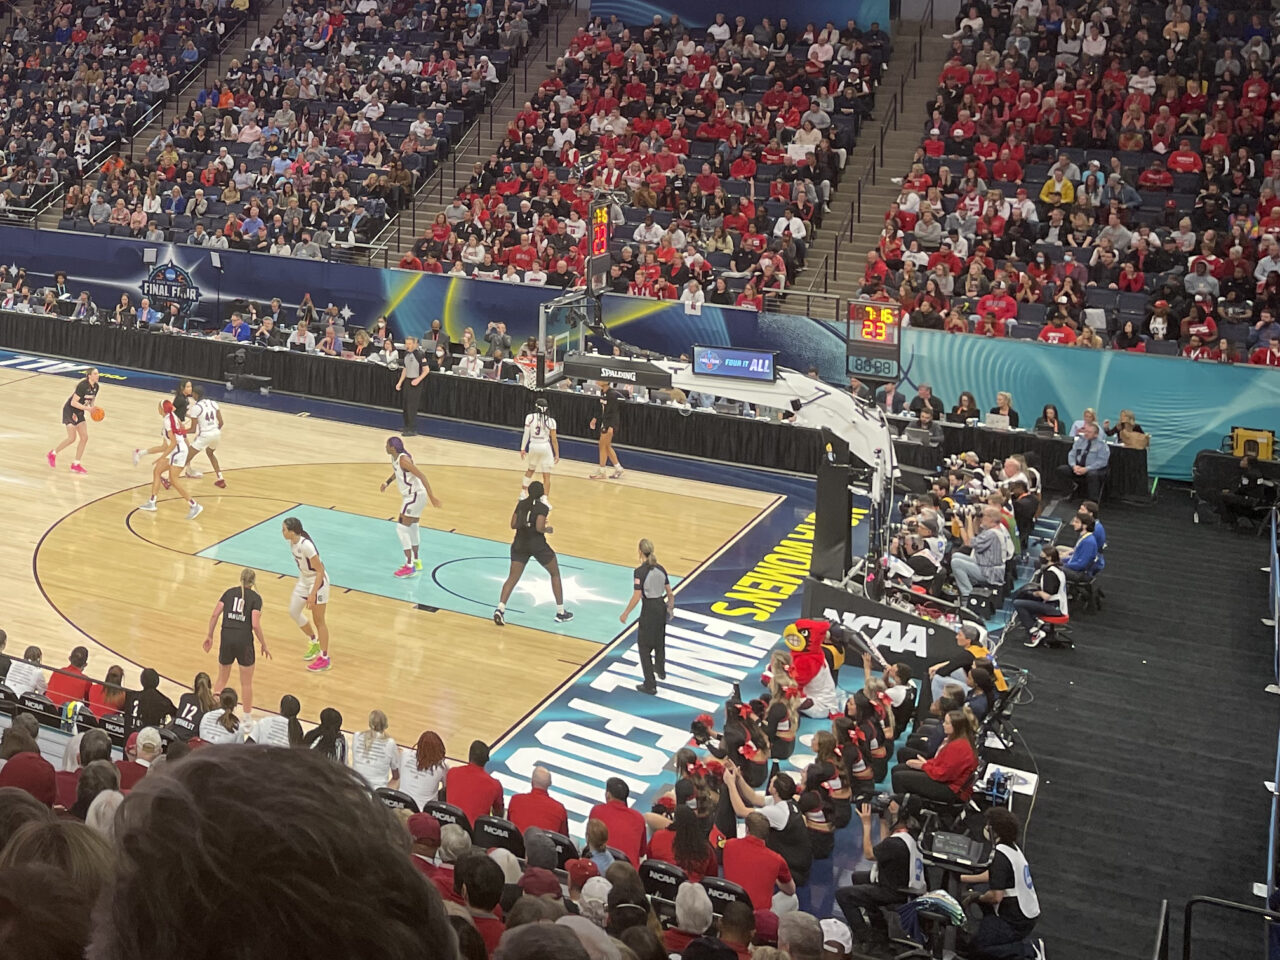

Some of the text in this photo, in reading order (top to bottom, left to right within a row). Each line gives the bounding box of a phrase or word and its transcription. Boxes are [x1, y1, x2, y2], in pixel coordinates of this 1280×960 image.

[144, 282, 170, 297] FINAL
[865, 306, 893, 324] 7:16
[862, 320, 886, 340] 23
[749, 358, 770, 373] ALL
[600, 367, 636, 382] SPALDING
[204, 411, 214, 422] 44
[710, 539, 814, 622] WOMEN'S
[232, 597, 244, 613] 10
[181, 703, 198, 721] 12
[431, 810, 457, 824] NCAA
[483, 824, 509, 838] NCAA
[649, 870, 676, 885] NCAA
[708, 888, 736, 902] NCAA
